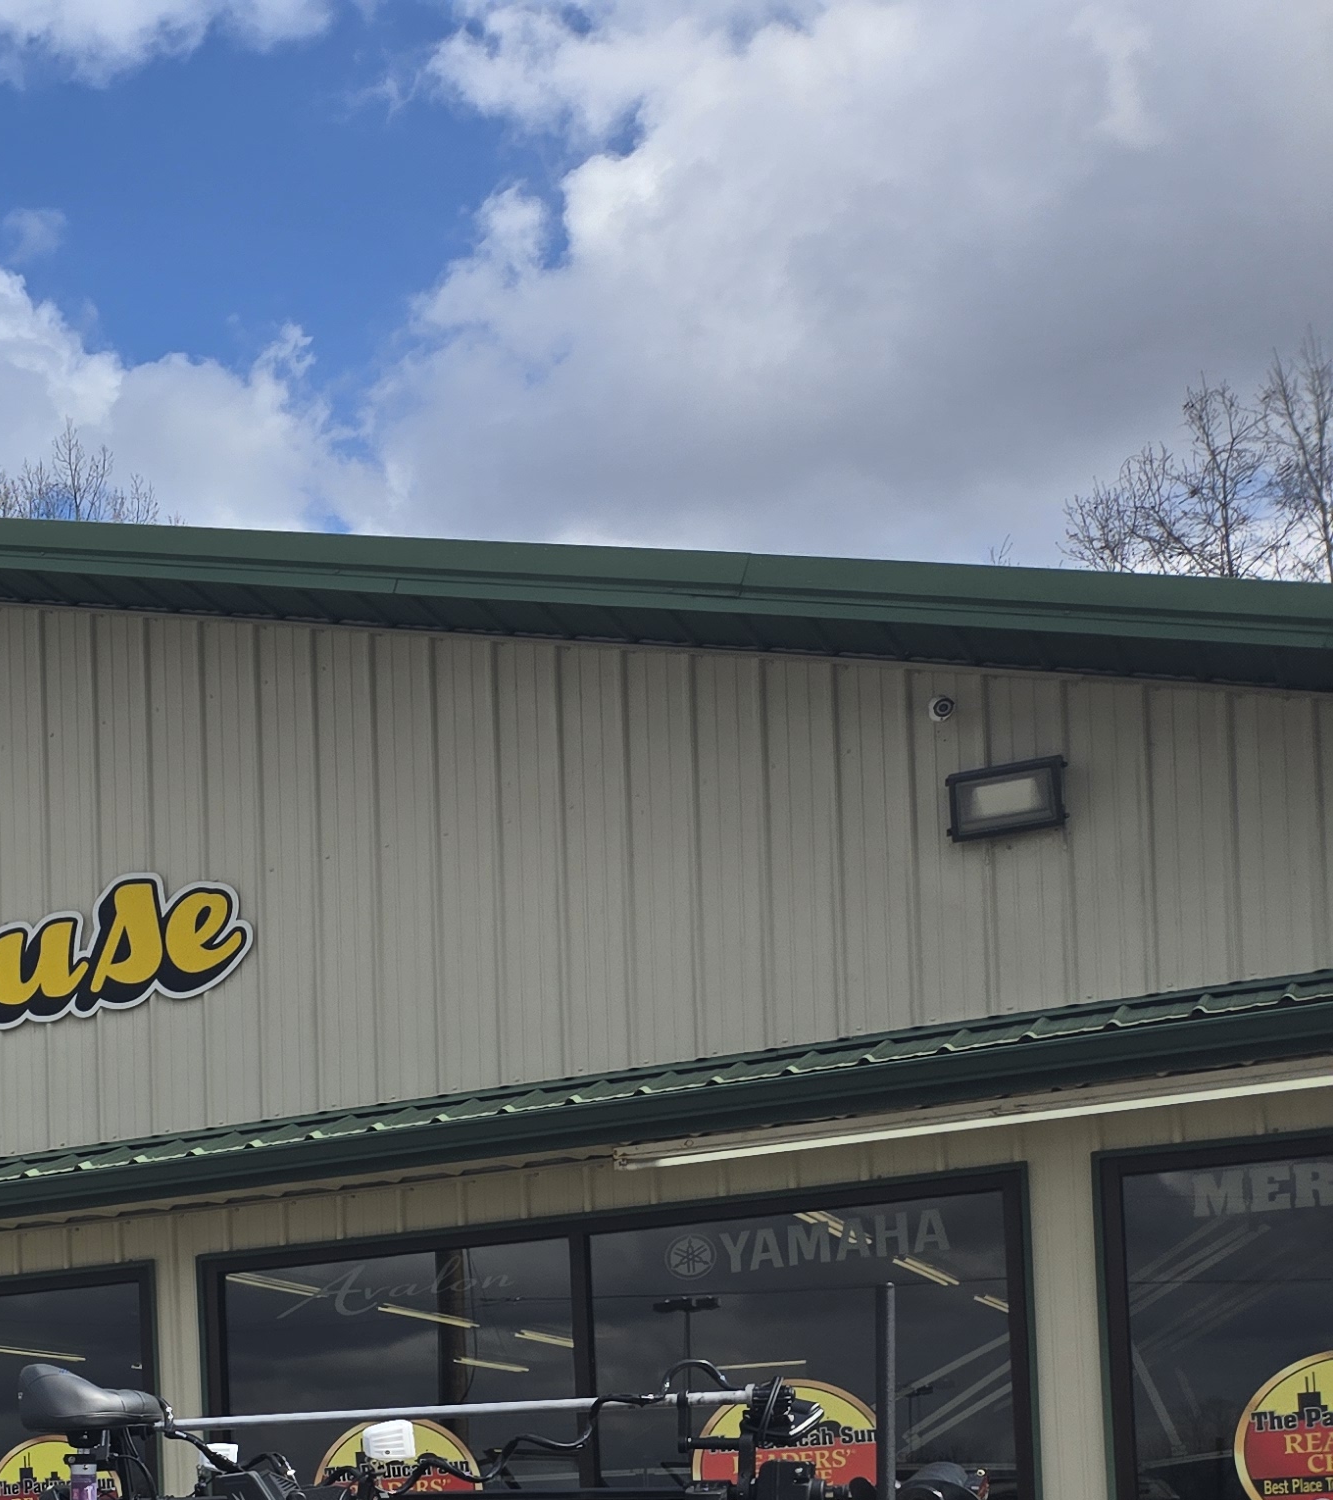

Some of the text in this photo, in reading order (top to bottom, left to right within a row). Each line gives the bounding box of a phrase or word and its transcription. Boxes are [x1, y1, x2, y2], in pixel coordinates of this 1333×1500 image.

[719, 1208, 950, 1273] YAMAHA
[277, 1255, 515, 1319] Avalon
[1251, 1410, 1299, 1432] The
[1264, 1480, 1289, 1495] Best
[1292, 1478, 1323, 1493] Place
